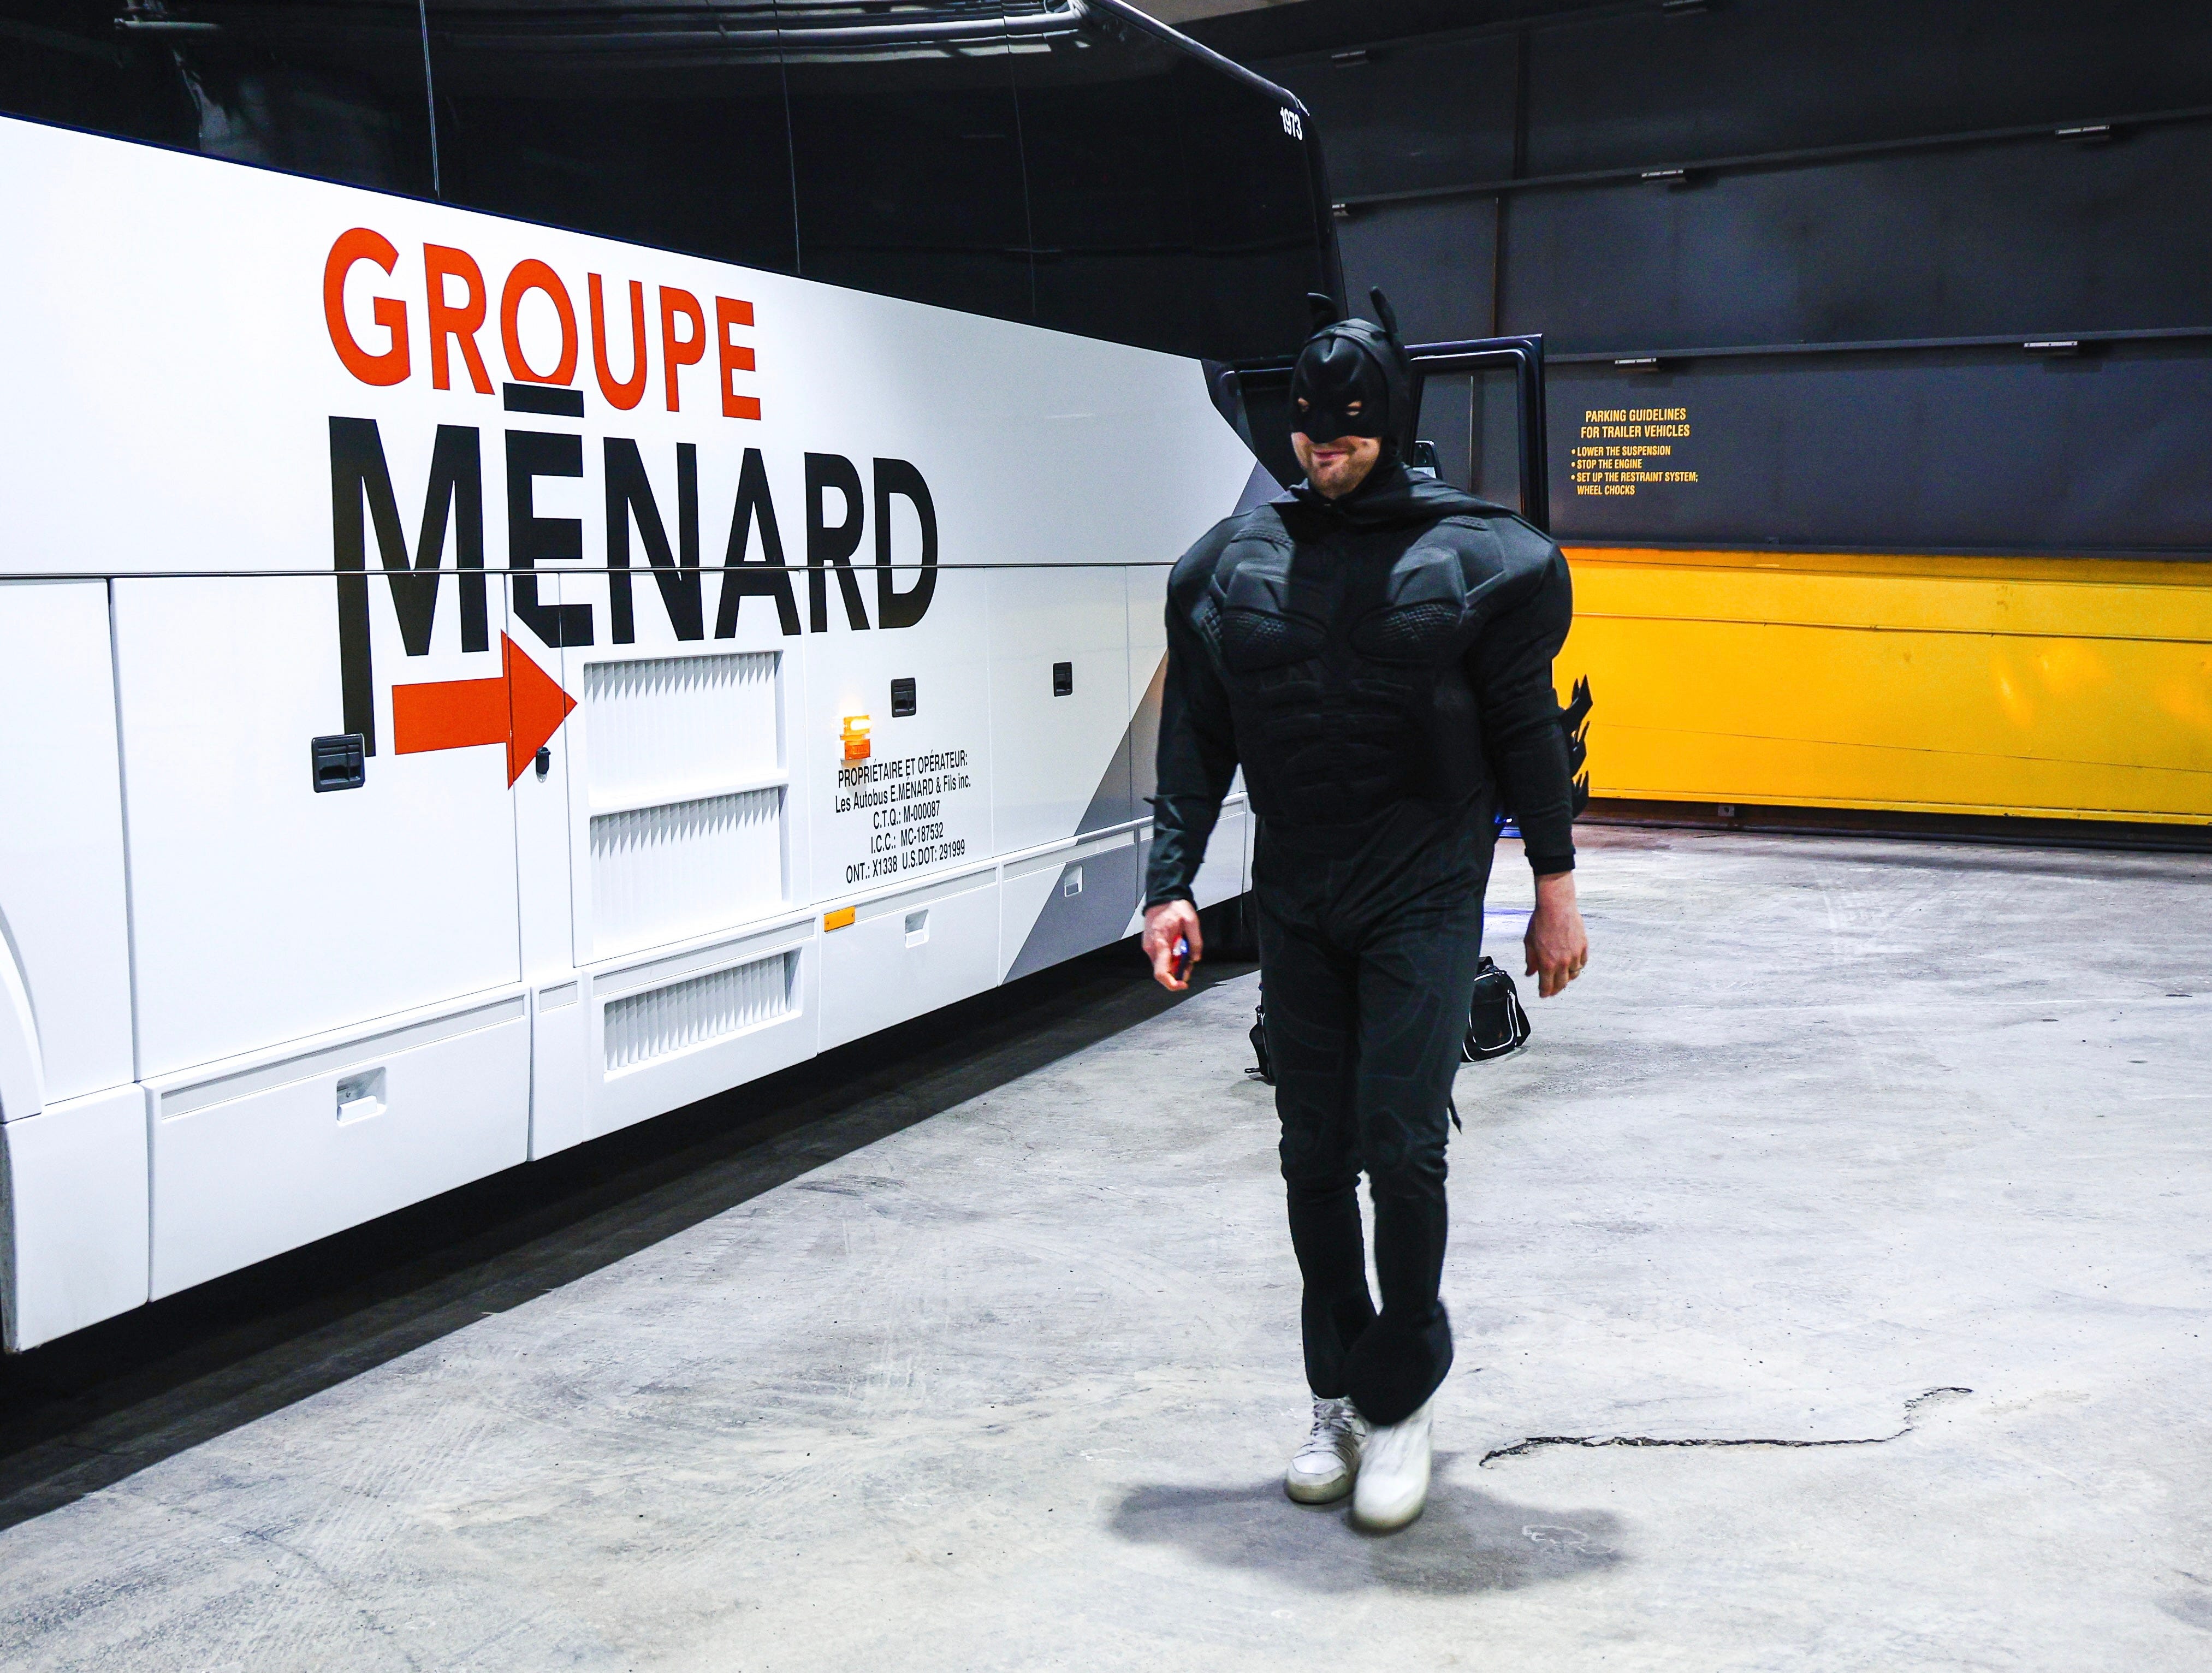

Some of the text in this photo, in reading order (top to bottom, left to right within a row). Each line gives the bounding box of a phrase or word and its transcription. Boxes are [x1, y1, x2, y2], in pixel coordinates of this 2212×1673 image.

[1280, 106, 1303, 140] 1973
[323, 227, 762, 421] GROUPE
[1585, 408, 1686, 422] PARKING GUIDELINES
[1581, 424, 1690, 438] FOR TRAILER VEHICLES
[1577, 445, 1671, 456] LOWER THE SUSPENSION
[1577, 459, 1642, 469] STOP THE ENGINE
[1577, 472, 1591, 482] SET
[1592, 472, 1603, 482] UP
[1604, 472, 1619, 482] THE
[1621, 472, 1663, 482] RESTRAINT
[1577, 485, 1635, 495] WHEEL CHOCKS
[839, 750, 968, 788] PROPRIÉTAIRE ET OPÉRATEUR:
[835, 795, 850, 813] Les
[853, 788, 888, 810] Autobus
[936, 777, 941, 793] &
[944, 775, 956, 792] Fils
[958, 773, 971, 789] inc.
[874, 800, 940, 829] C.T.Q.: M-000087
[871, 822, 943, 854] I.C.C.: MC-187532
[846, 862, 870, 883] ONT.:
[873, 856, 897, 877] X1338
[939, 839, 965, 861] 291999
